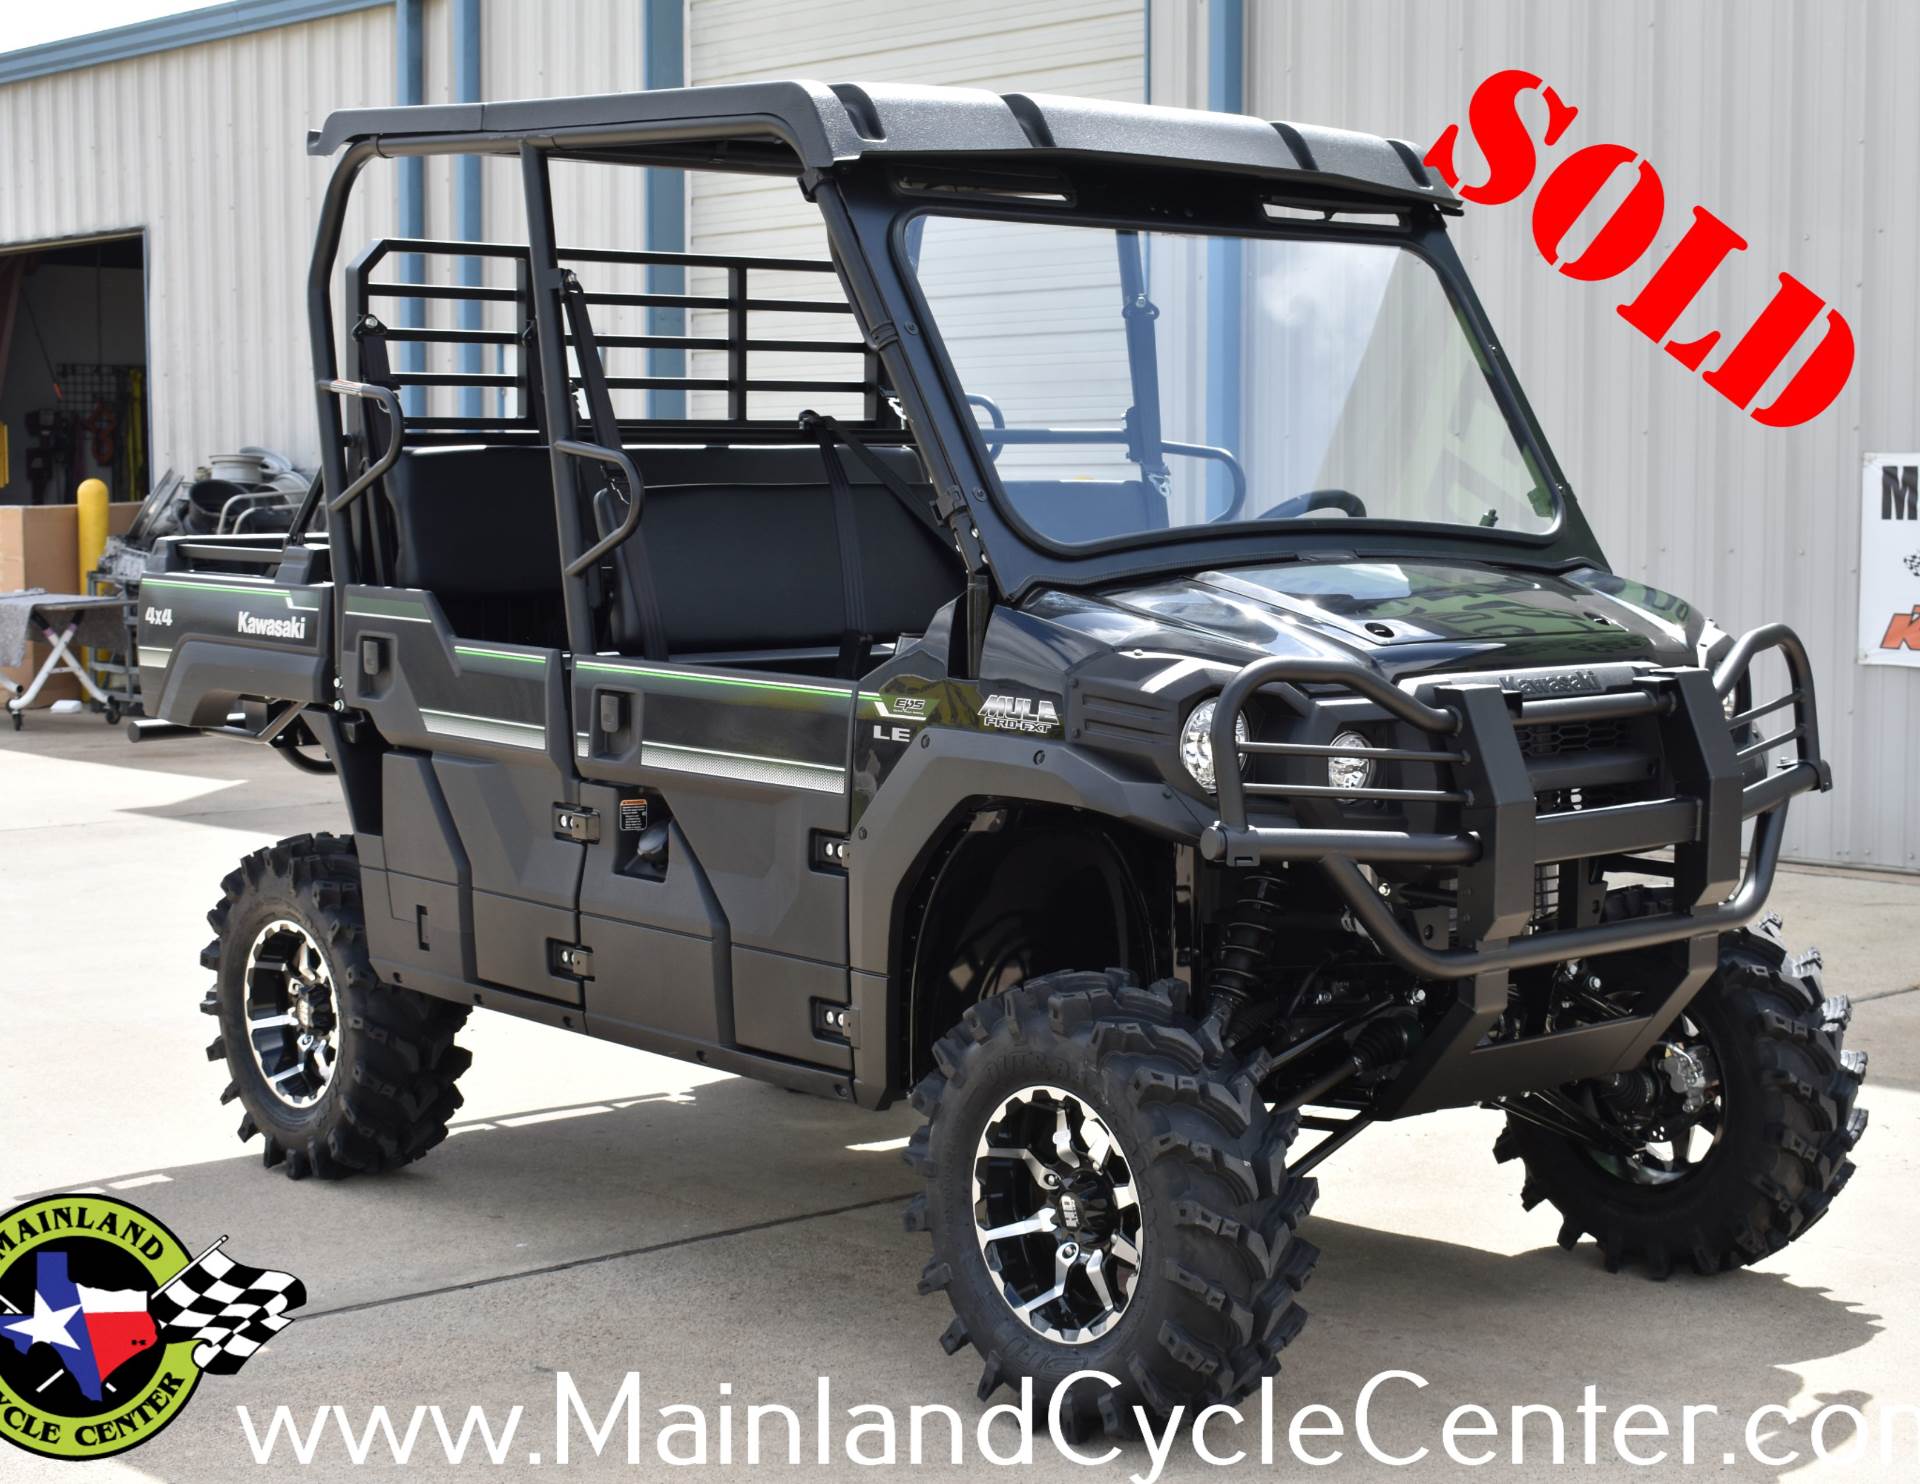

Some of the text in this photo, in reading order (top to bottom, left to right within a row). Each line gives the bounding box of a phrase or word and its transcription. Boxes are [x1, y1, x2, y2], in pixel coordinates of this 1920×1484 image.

[145, 606, 172, 626] 4x4
[237, 611, 305, 639] Kawasaki
[977, 694, 1060, 725] MULE
[873, 725, 911, 742] LE
